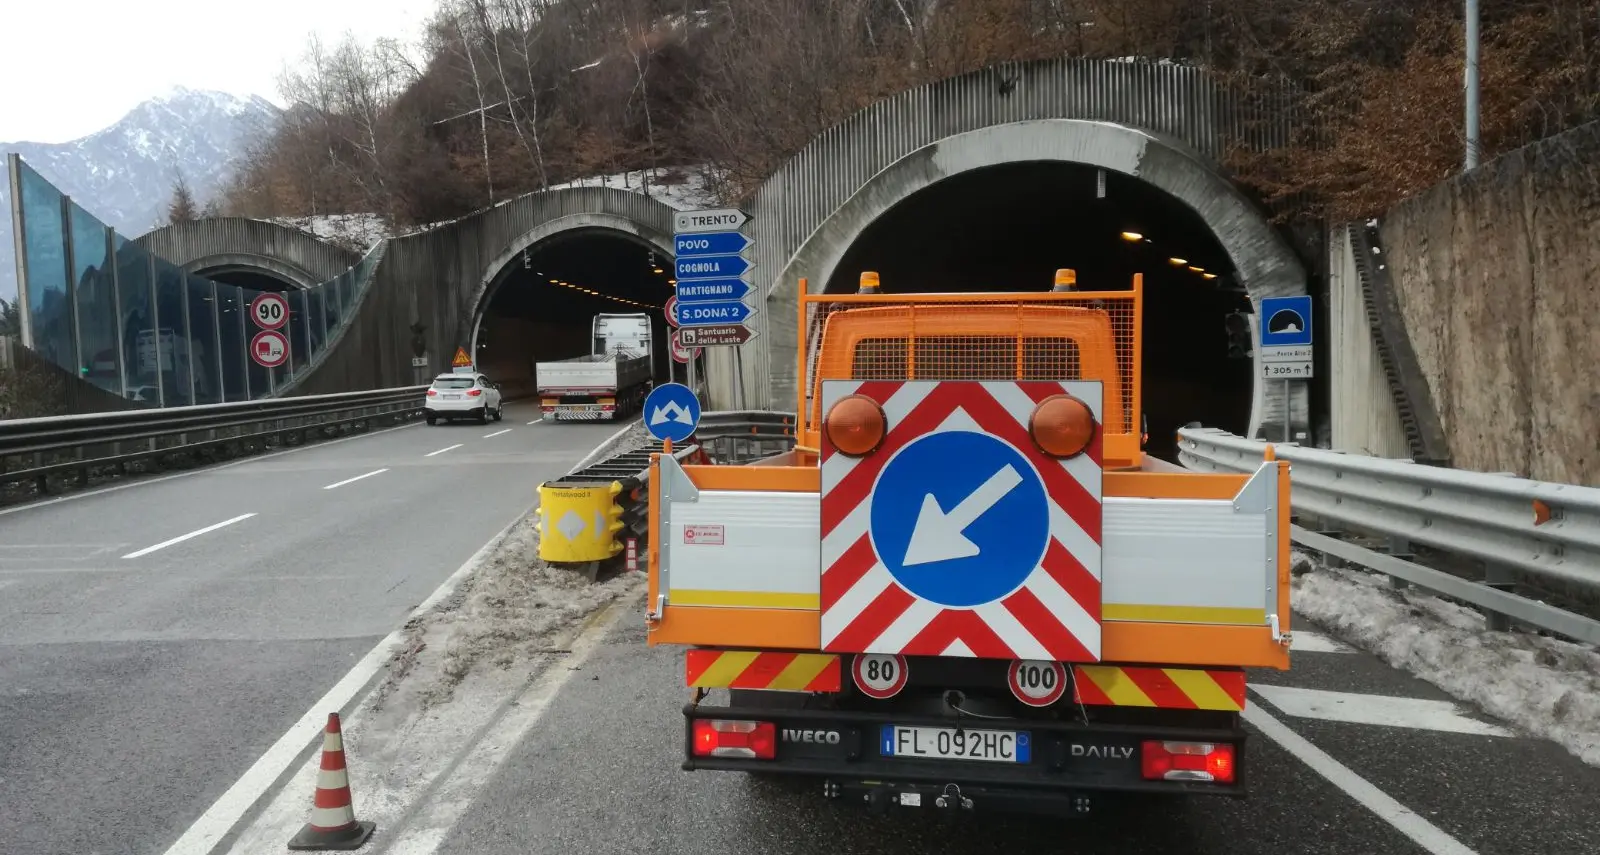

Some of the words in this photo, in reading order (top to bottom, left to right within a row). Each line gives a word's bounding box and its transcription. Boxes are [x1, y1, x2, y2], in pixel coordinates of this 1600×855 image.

[691, 214, 737, 226] TRENTO
[678, 239, 709, 250] POVO
[679, 262, 720, 273] COGNOLA
[679, 285, 733, 296] MARTIGNANO
[260, 303, 281, 320] 90
[698, 328, 737, 336] Santuario
[720, 335, 741, 343] Laste
[867, 659, 894, 681] 80
[1019, 665, 1055, 689] 100
[783, 728, 840, 744] IVECO
[1071, 744, 1134, 759] DAILY
